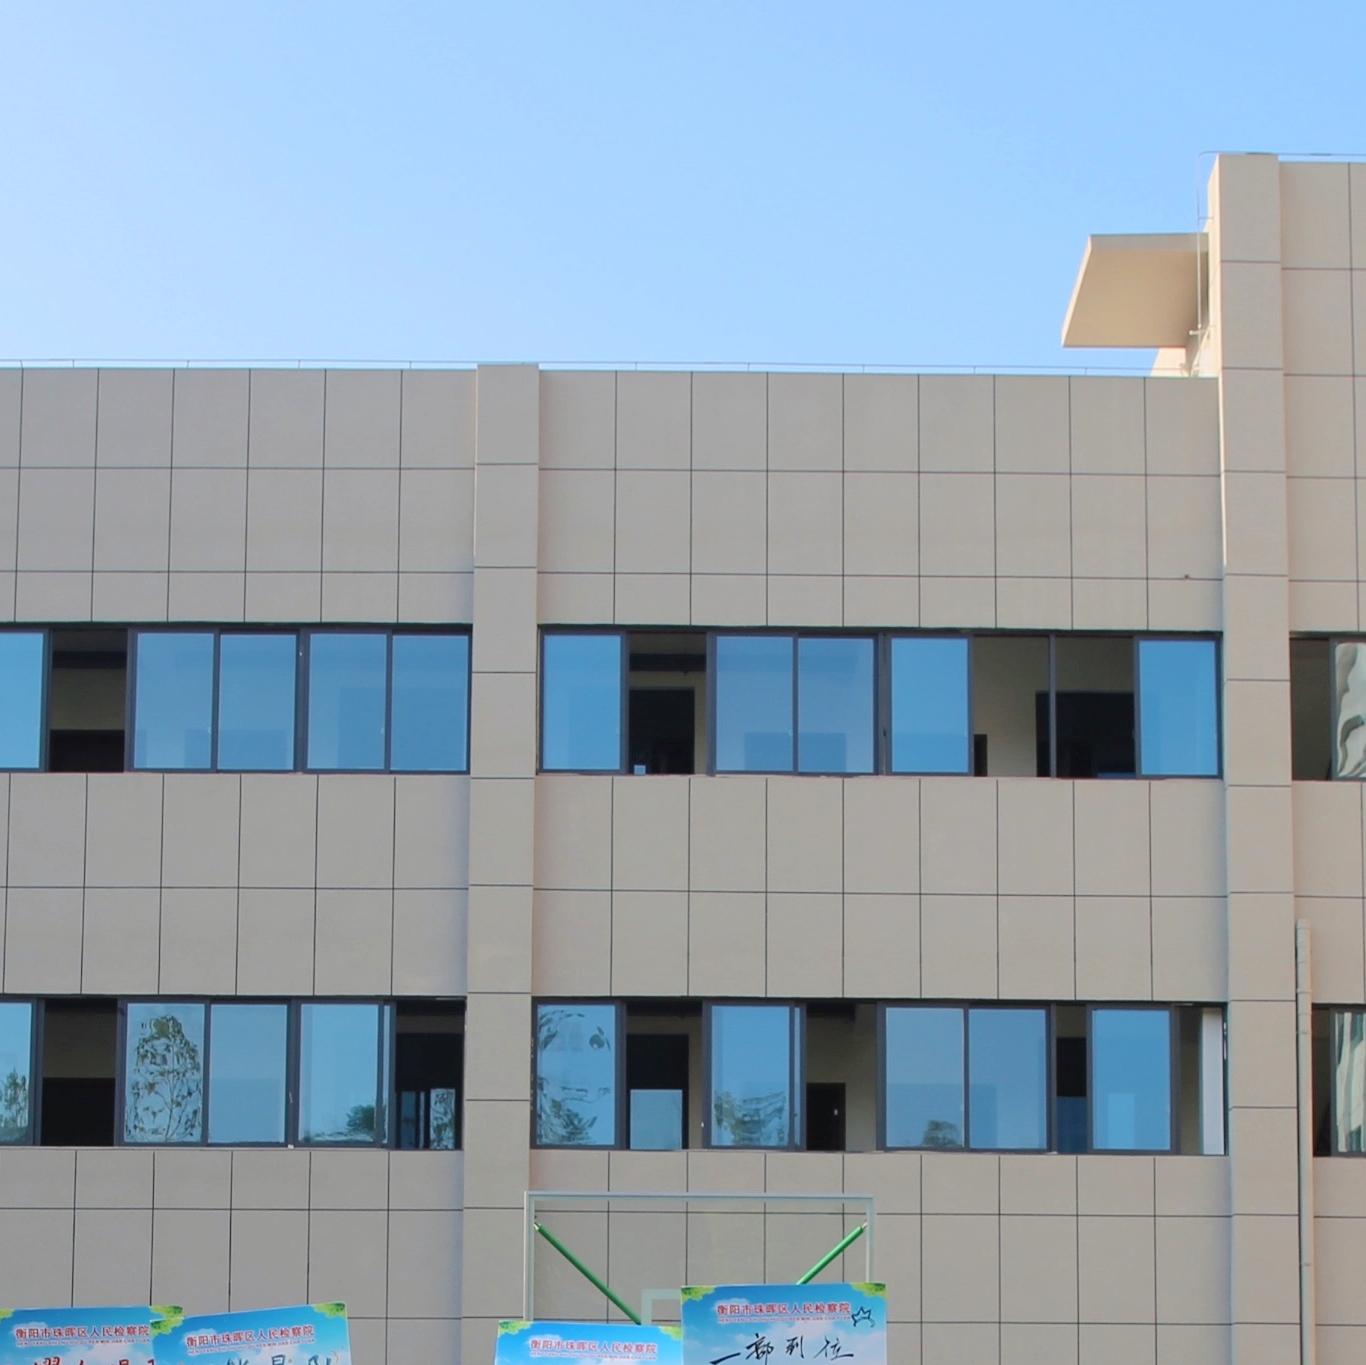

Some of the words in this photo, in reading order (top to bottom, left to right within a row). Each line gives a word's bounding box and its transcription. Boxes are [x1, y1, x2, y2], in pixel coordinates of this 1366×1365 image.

[716, 1302, 852, 1316] 衡阳市珠晖区人民检察院
[15, 1325, 150, 1340] 衡阳市珠晖区人民检察院
[185, 1324, 315, 1348] 衡阳市珠晖区人民检察院
[530, 1339, 658, 1354] 衡阳市珠晖区人民检察院
